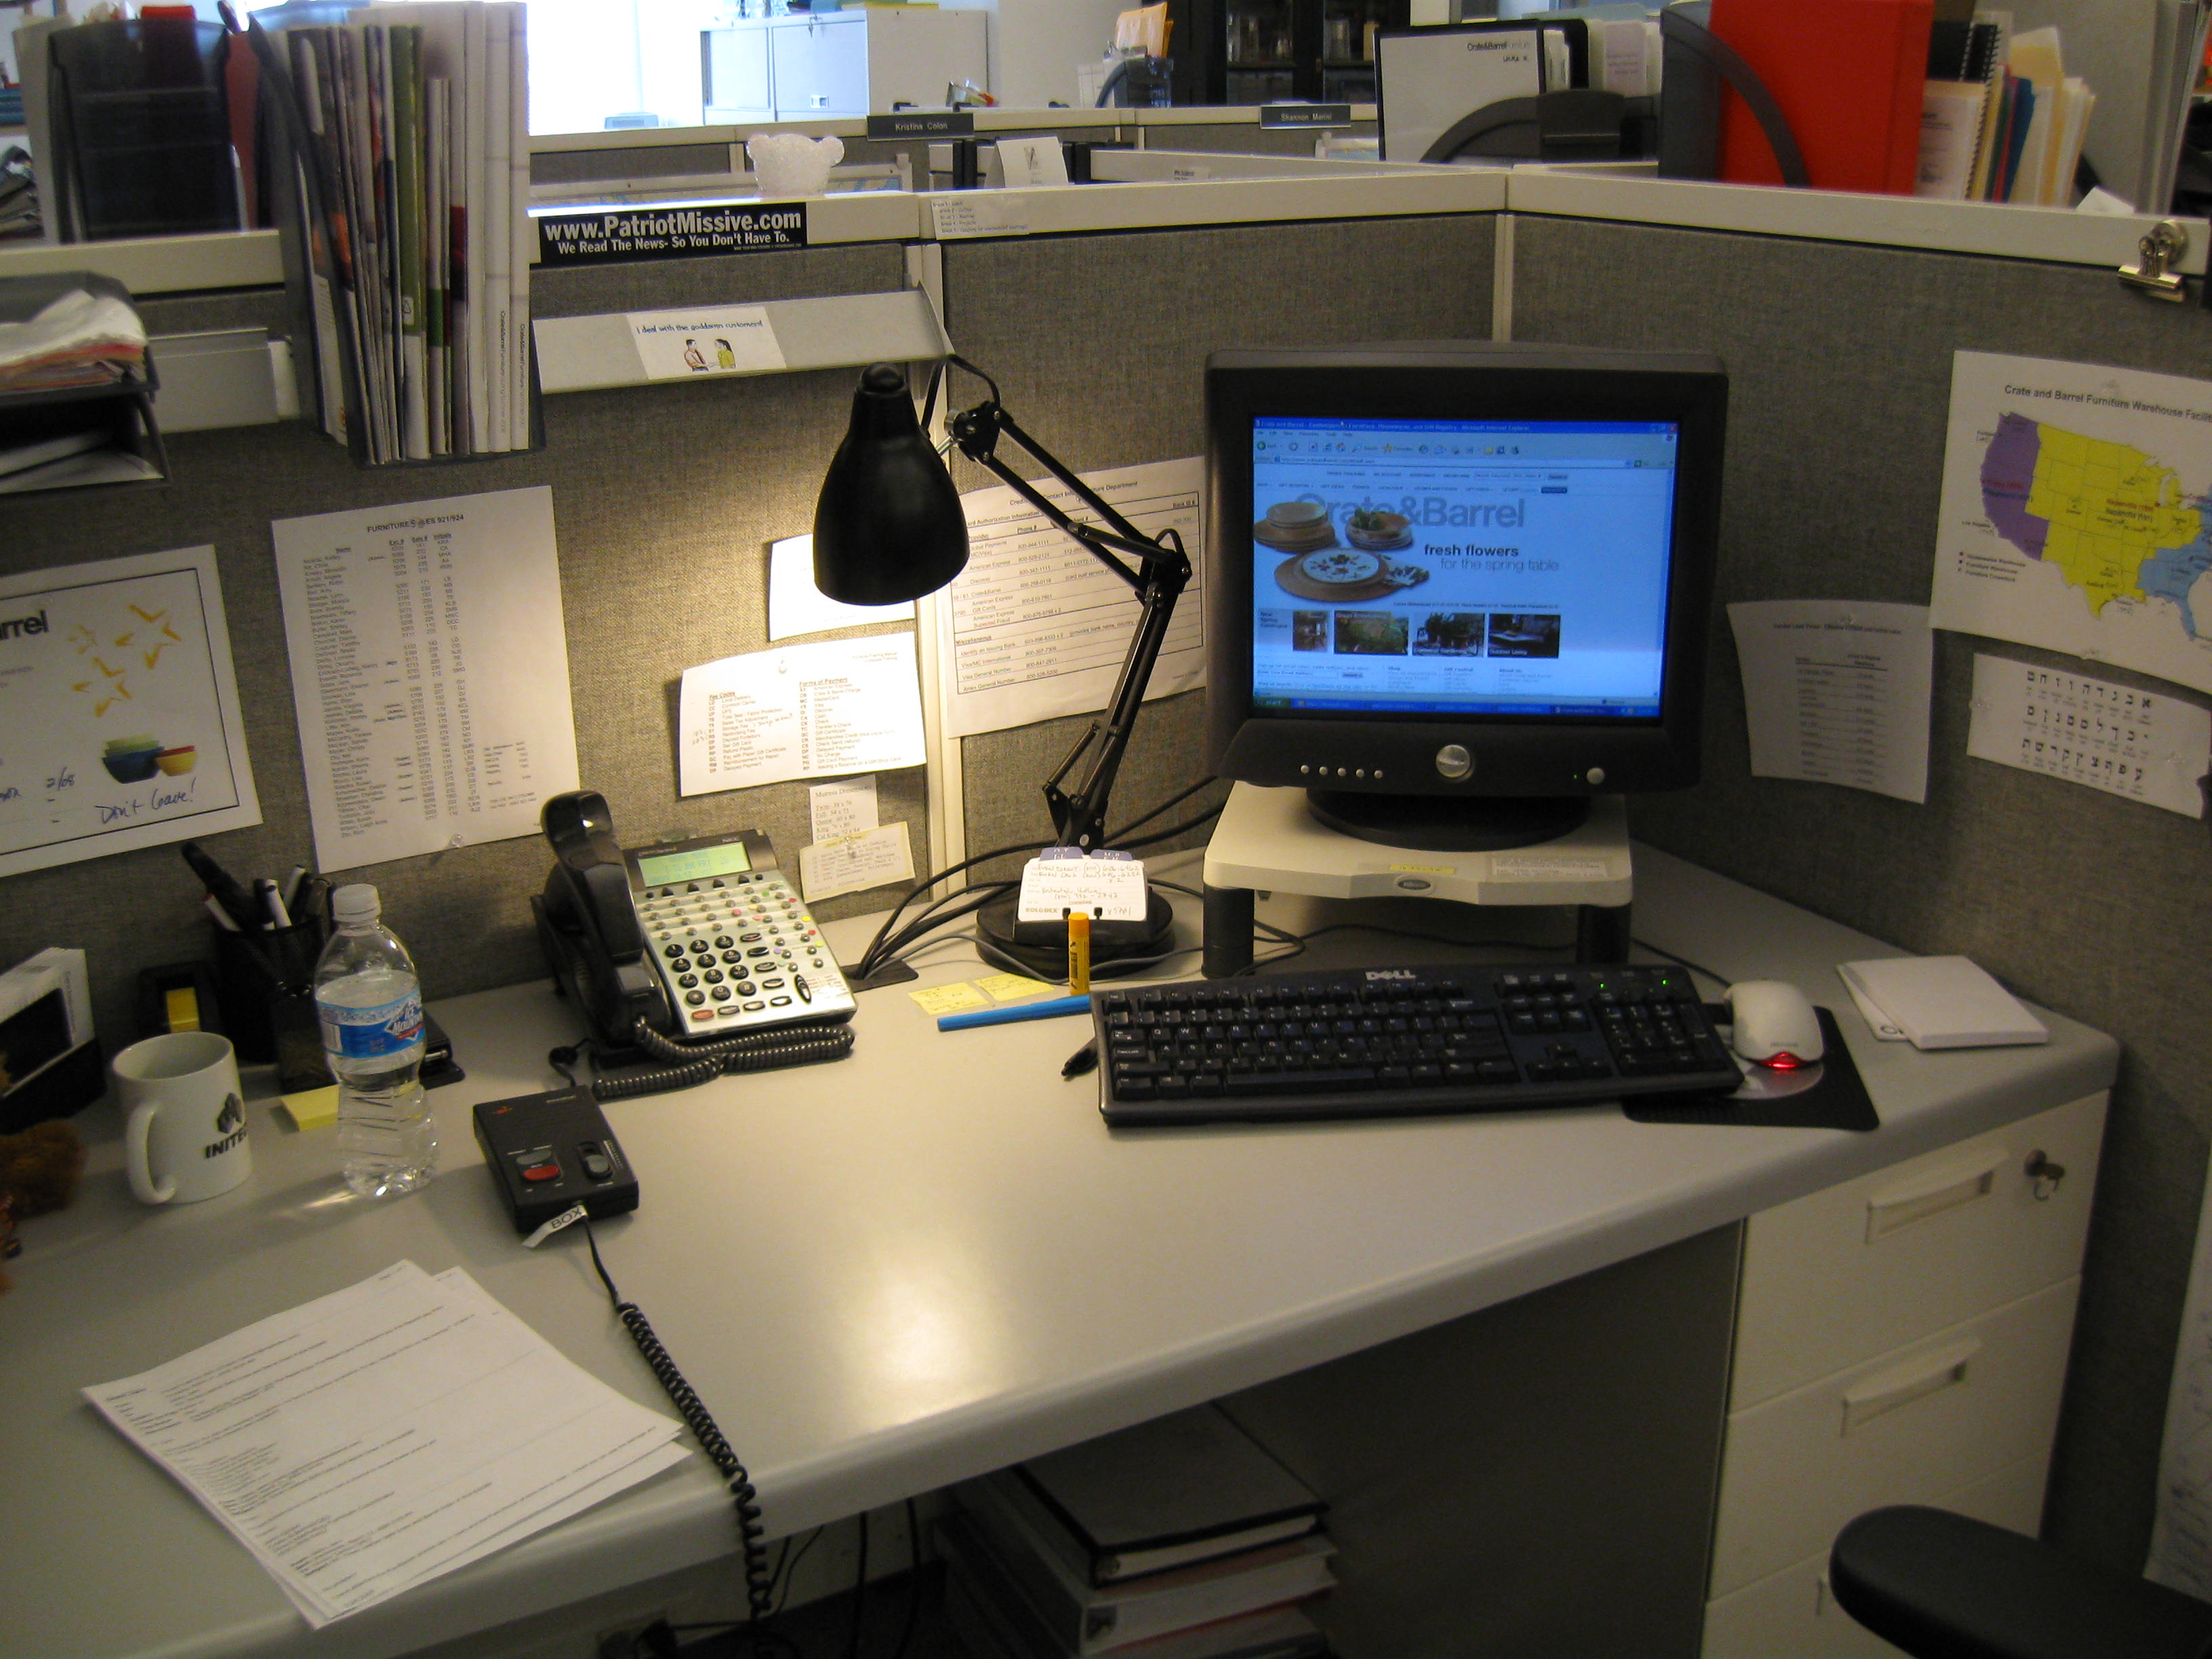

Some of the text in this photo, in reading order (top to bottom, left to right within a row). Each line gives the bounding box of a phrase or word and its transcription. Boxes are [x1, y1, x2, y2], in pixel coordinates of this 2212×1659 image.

[927, 122, 948, 130] Colon
[545, 211, 801, 241] www.PatriotMissive.com
[558, 231, 790, 255] We Read The News- So You Don't Have To.
[2005, 385, 2030, 397] Crate
[2033, 389, 2051, 399] and
[2054, 390, 2083, 403] Barrel
[2086, 394, 2129, 409] Furniture
[2132, 401, 2182, 417] Warehouse
[1106, 482, 1138, 492] Department
[437, 514, 464, 524] 921/924
[1424, 543, 1519, 558] fresh flowers
[1440, 558, 1559, 575] for the spring table
[1365, 970, 1416, 981] DELL
[550, 1206, 583, 1229] BOX
